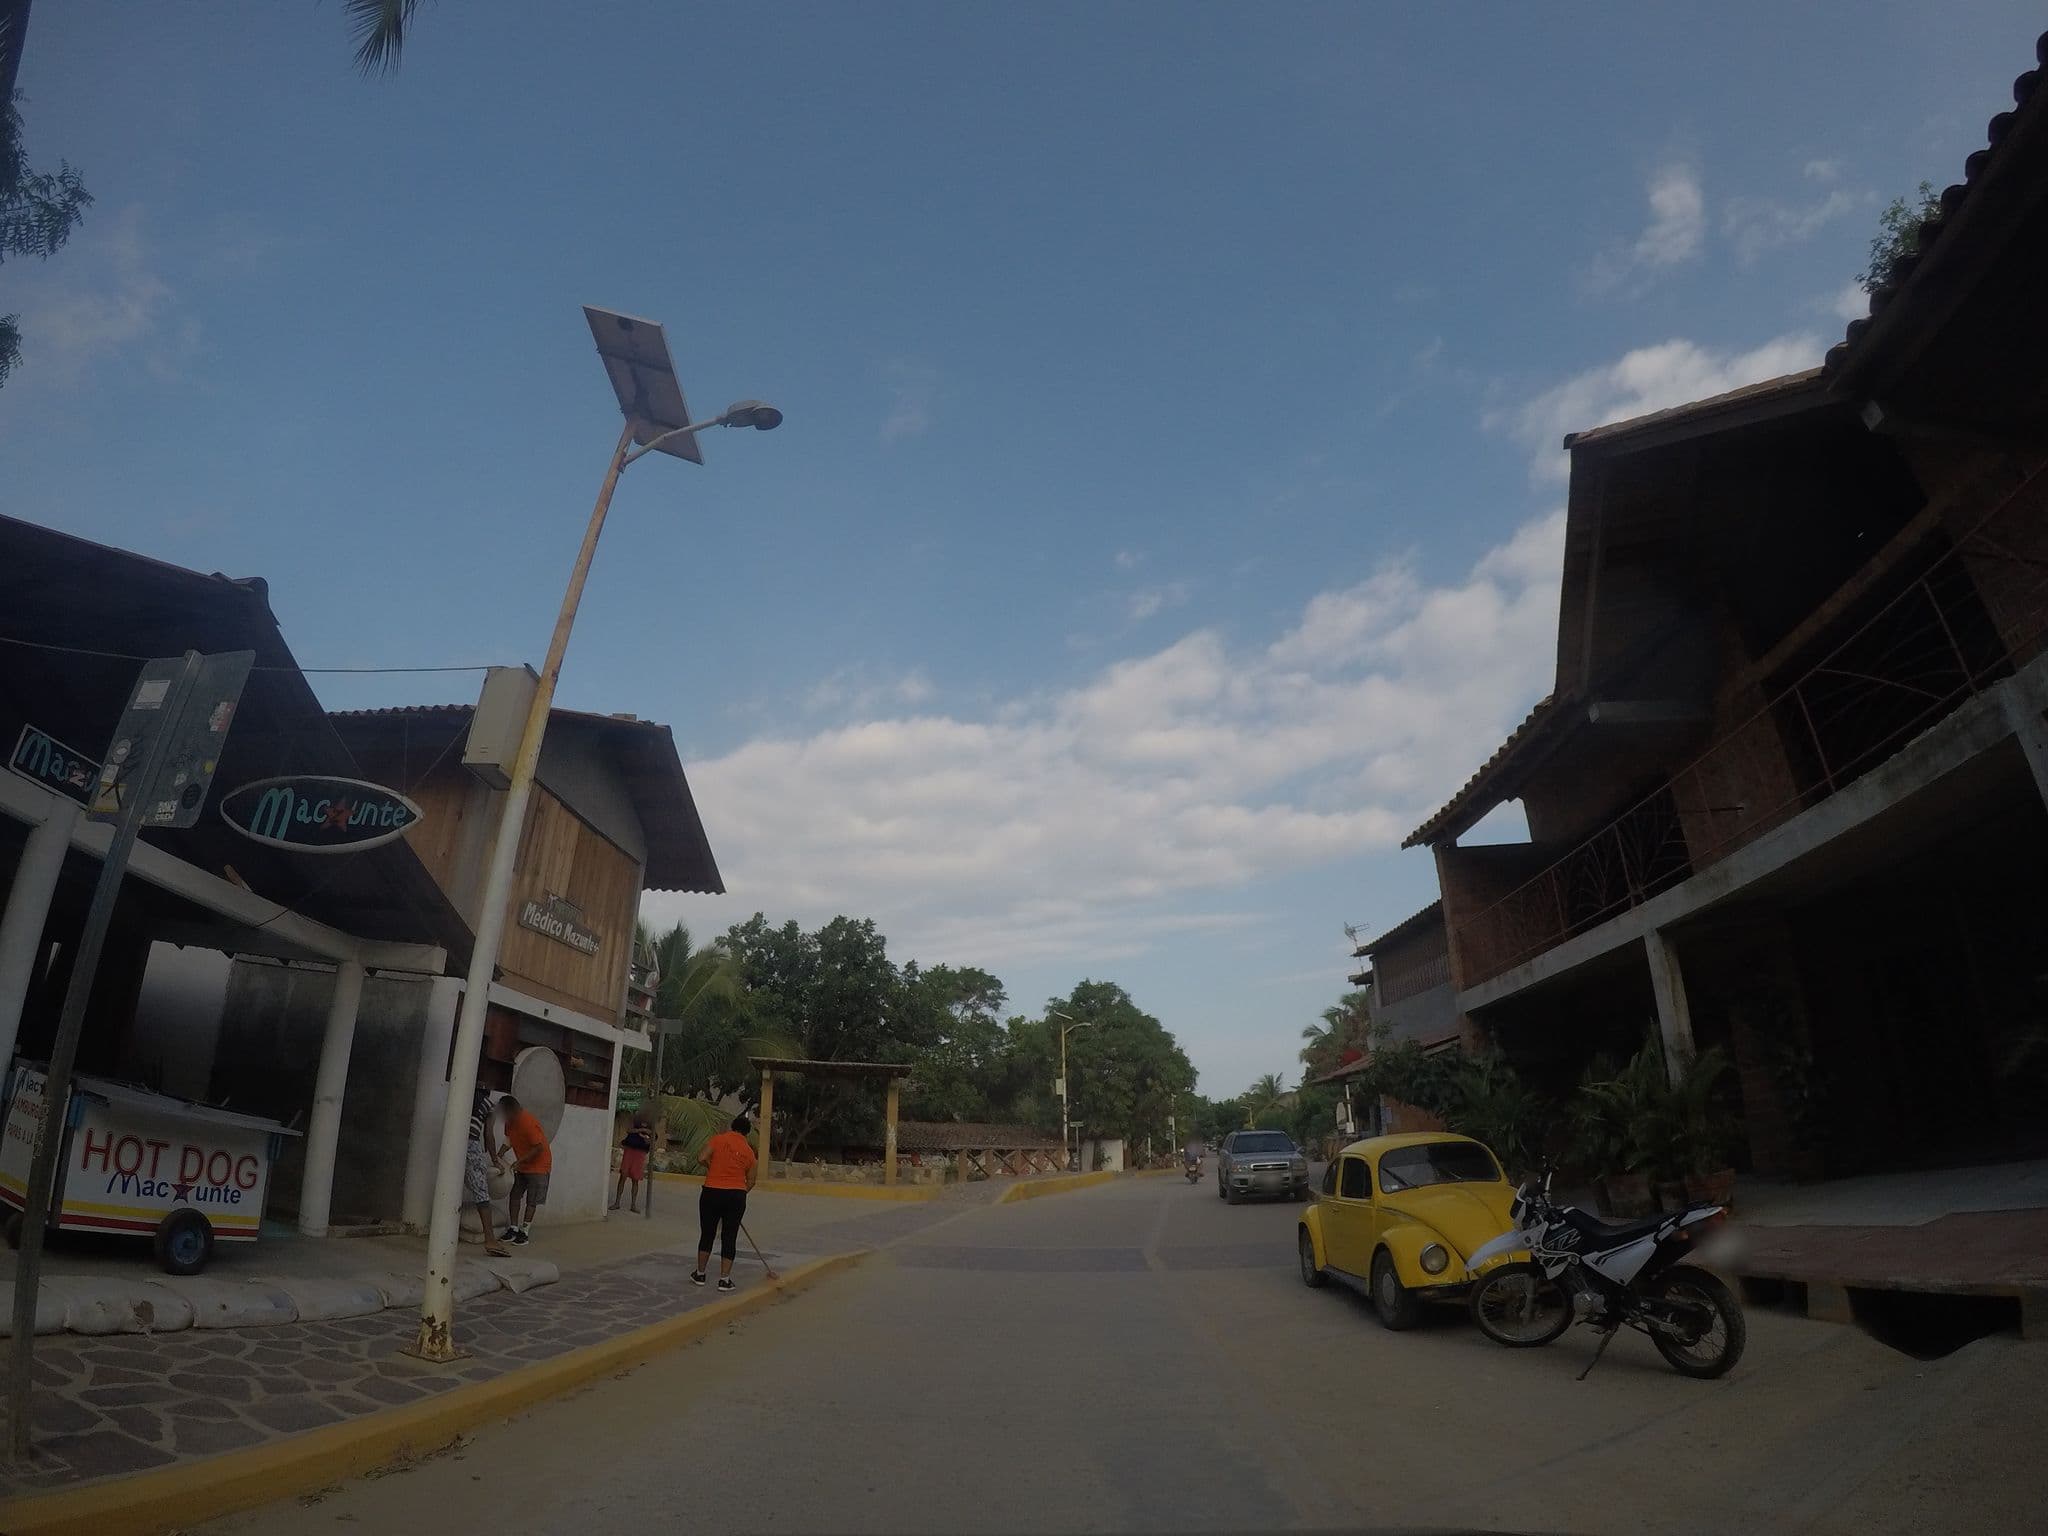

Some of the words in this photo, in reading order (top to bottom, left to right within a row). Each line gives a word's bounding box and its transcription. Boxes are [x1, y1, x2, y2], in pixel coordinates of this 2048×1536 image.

[523, 901, 563, 937] Médico
[82, 1127, 170, 1179] HOT
[180, 1144, 259, 1190] DOG
